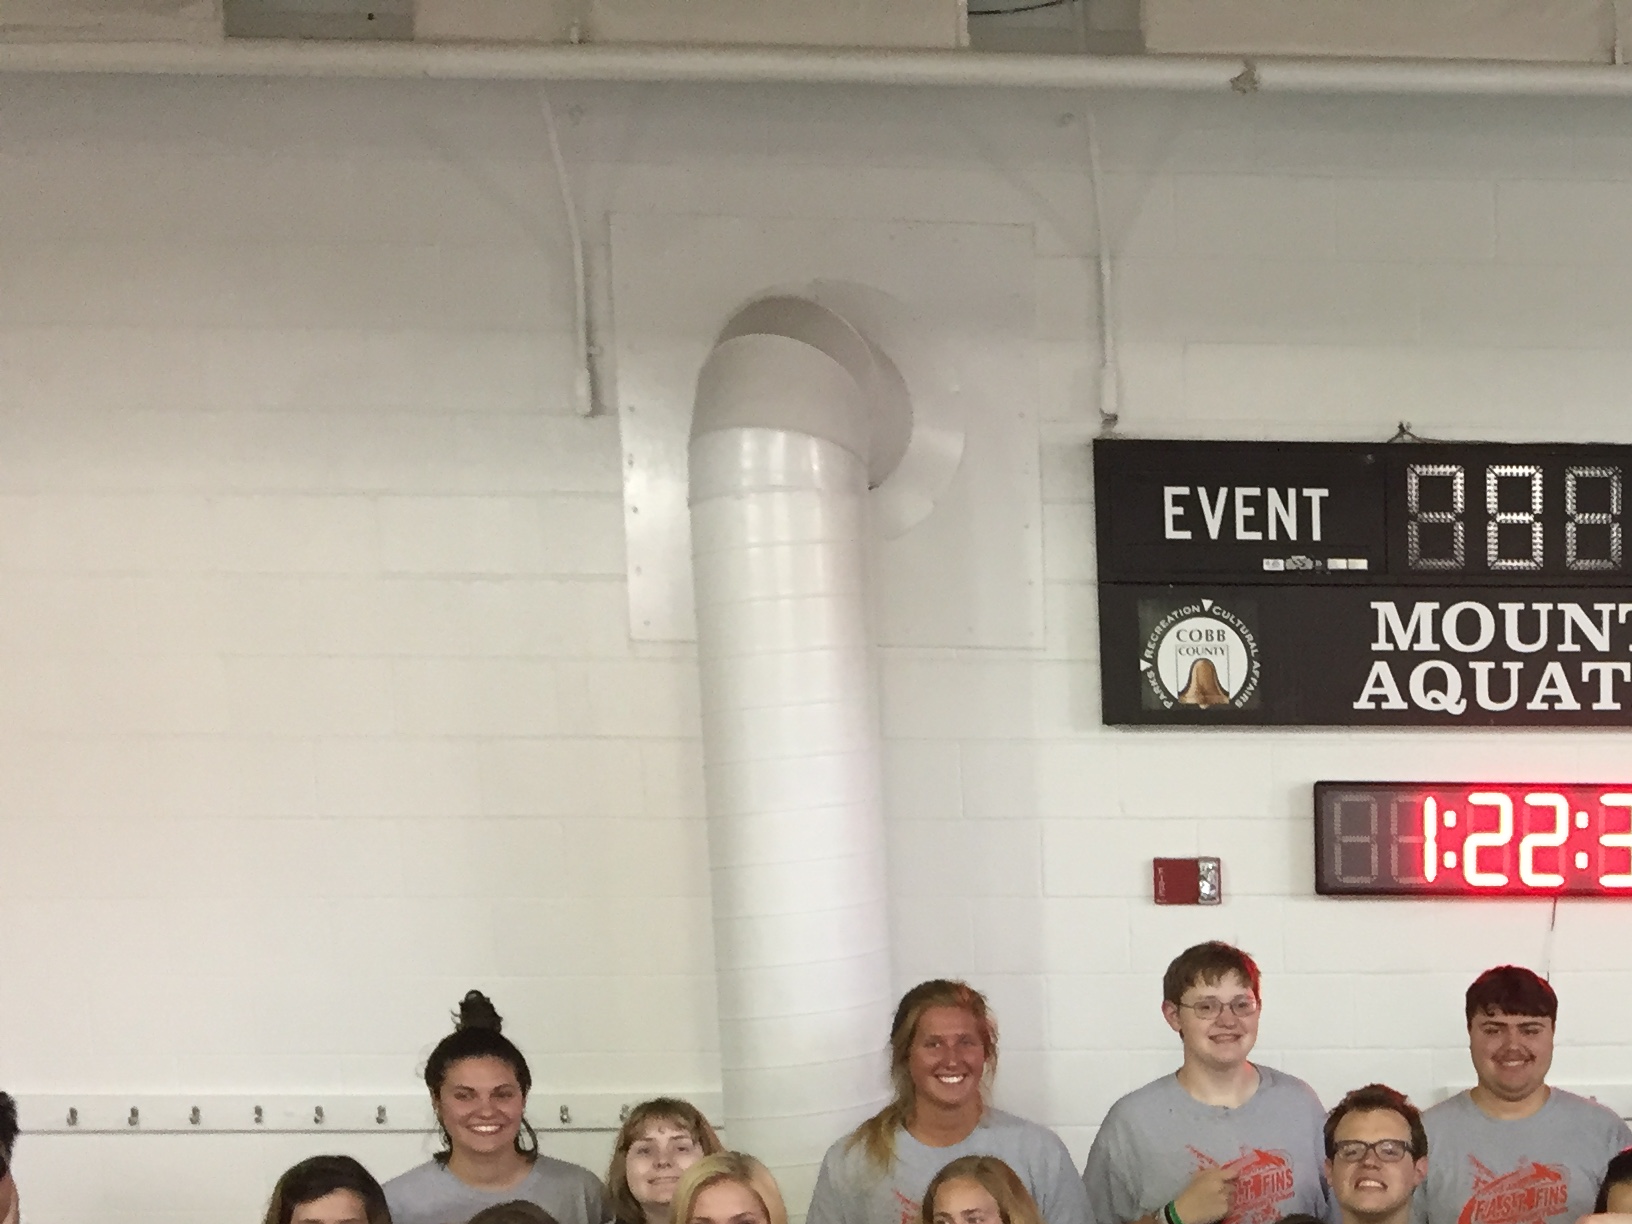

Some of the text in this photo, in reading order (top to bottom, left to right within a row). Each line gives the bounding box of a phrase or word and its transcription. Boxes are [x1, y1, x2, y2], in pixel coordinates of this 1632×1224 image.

[1163, 485, 1330, 542] EVENT
[1175, 628, 1227, 643] COBB
[1178, 646, 1226, 657] COUNTY
[1143, 603, 1262, 710] PARKS RECREATION CULTURAL AFFAIRS
